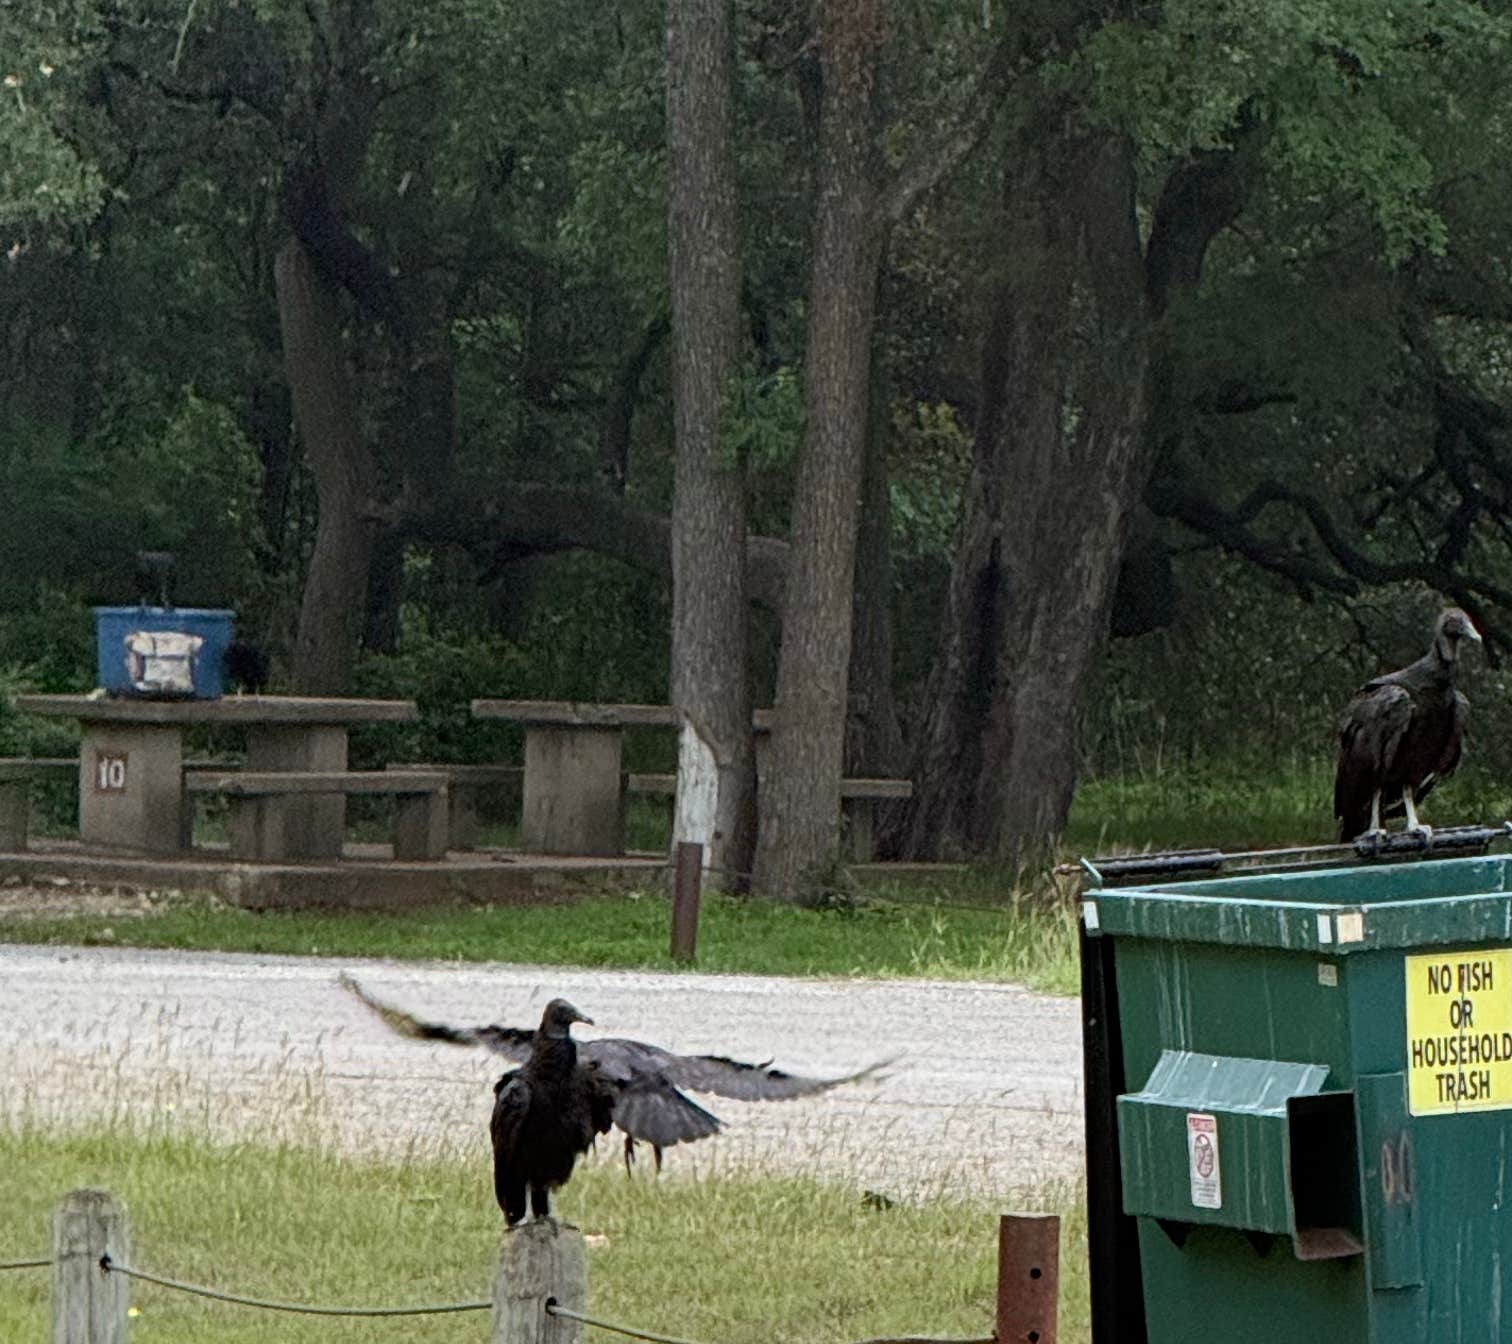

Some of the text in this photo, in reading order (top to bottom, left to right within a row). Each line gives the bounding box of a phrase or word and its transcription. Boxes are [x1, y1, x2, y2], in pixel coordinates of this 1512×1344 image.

[99, 757, 125, 789] 10
[1428, 961, 1493, 994] NO FISH
[1450, 1000, 1473, 1029] OR
[1412, 1033, 1512, 1068] HOUSEHOLD
[1435, 1070, 1490, 1102] TRASH
